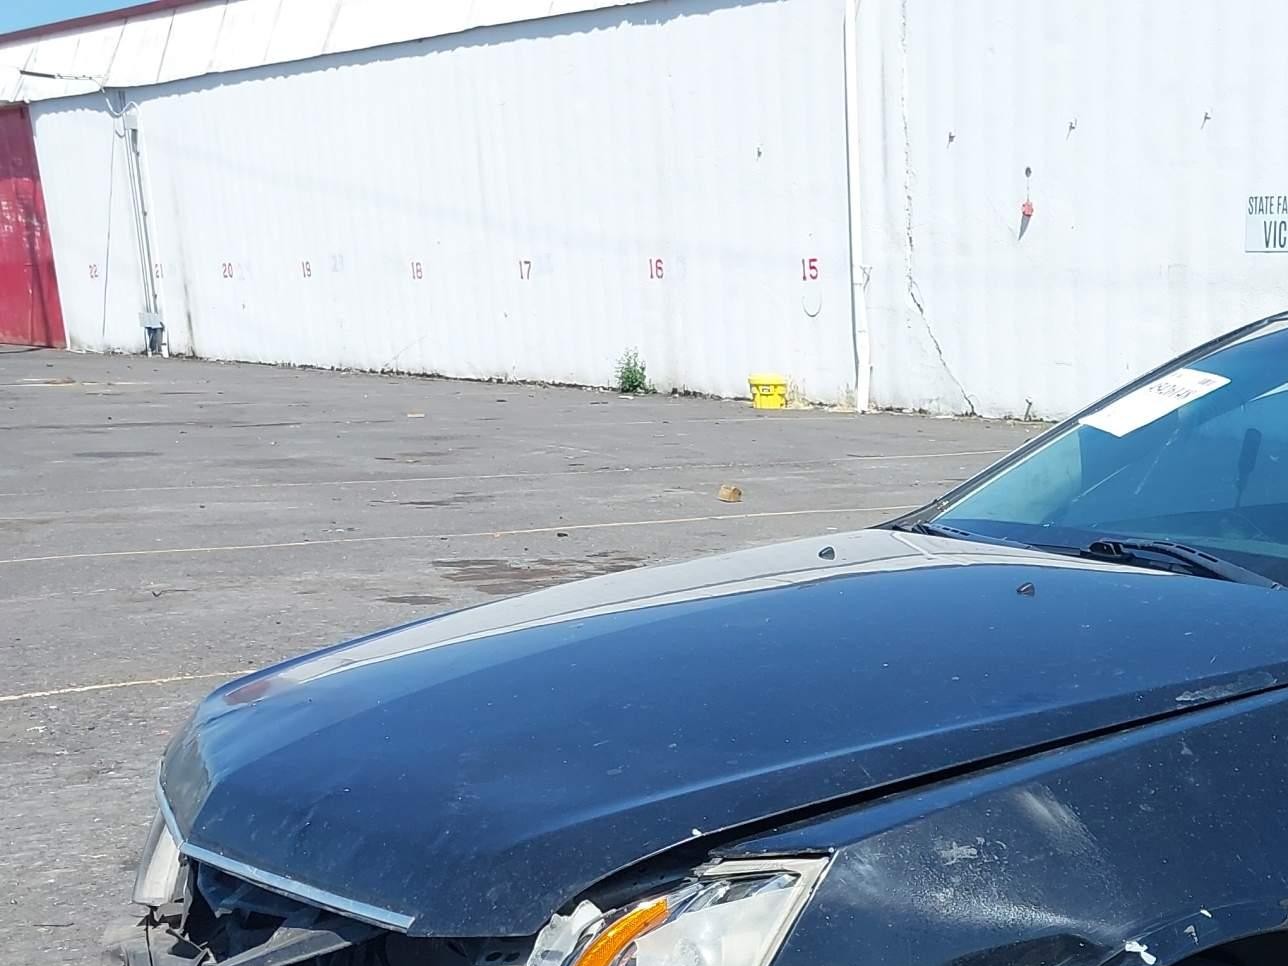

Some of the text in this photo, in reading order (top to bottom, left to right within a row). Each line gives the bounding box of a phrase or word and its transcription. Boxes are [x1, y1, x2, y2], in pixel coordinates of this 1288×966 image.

[1248, 195, 1275, 216] STATE
[1263, 220, 1288, 249] VIC
[222, 262, 234, 279] 20
[301, 261, 312, 279] 19
[411, 261, 424, 280] 18
[518, 260, 532, 280] 17
[649, 258, 665, 279] 16
[801, 258, 819, 281] 15
